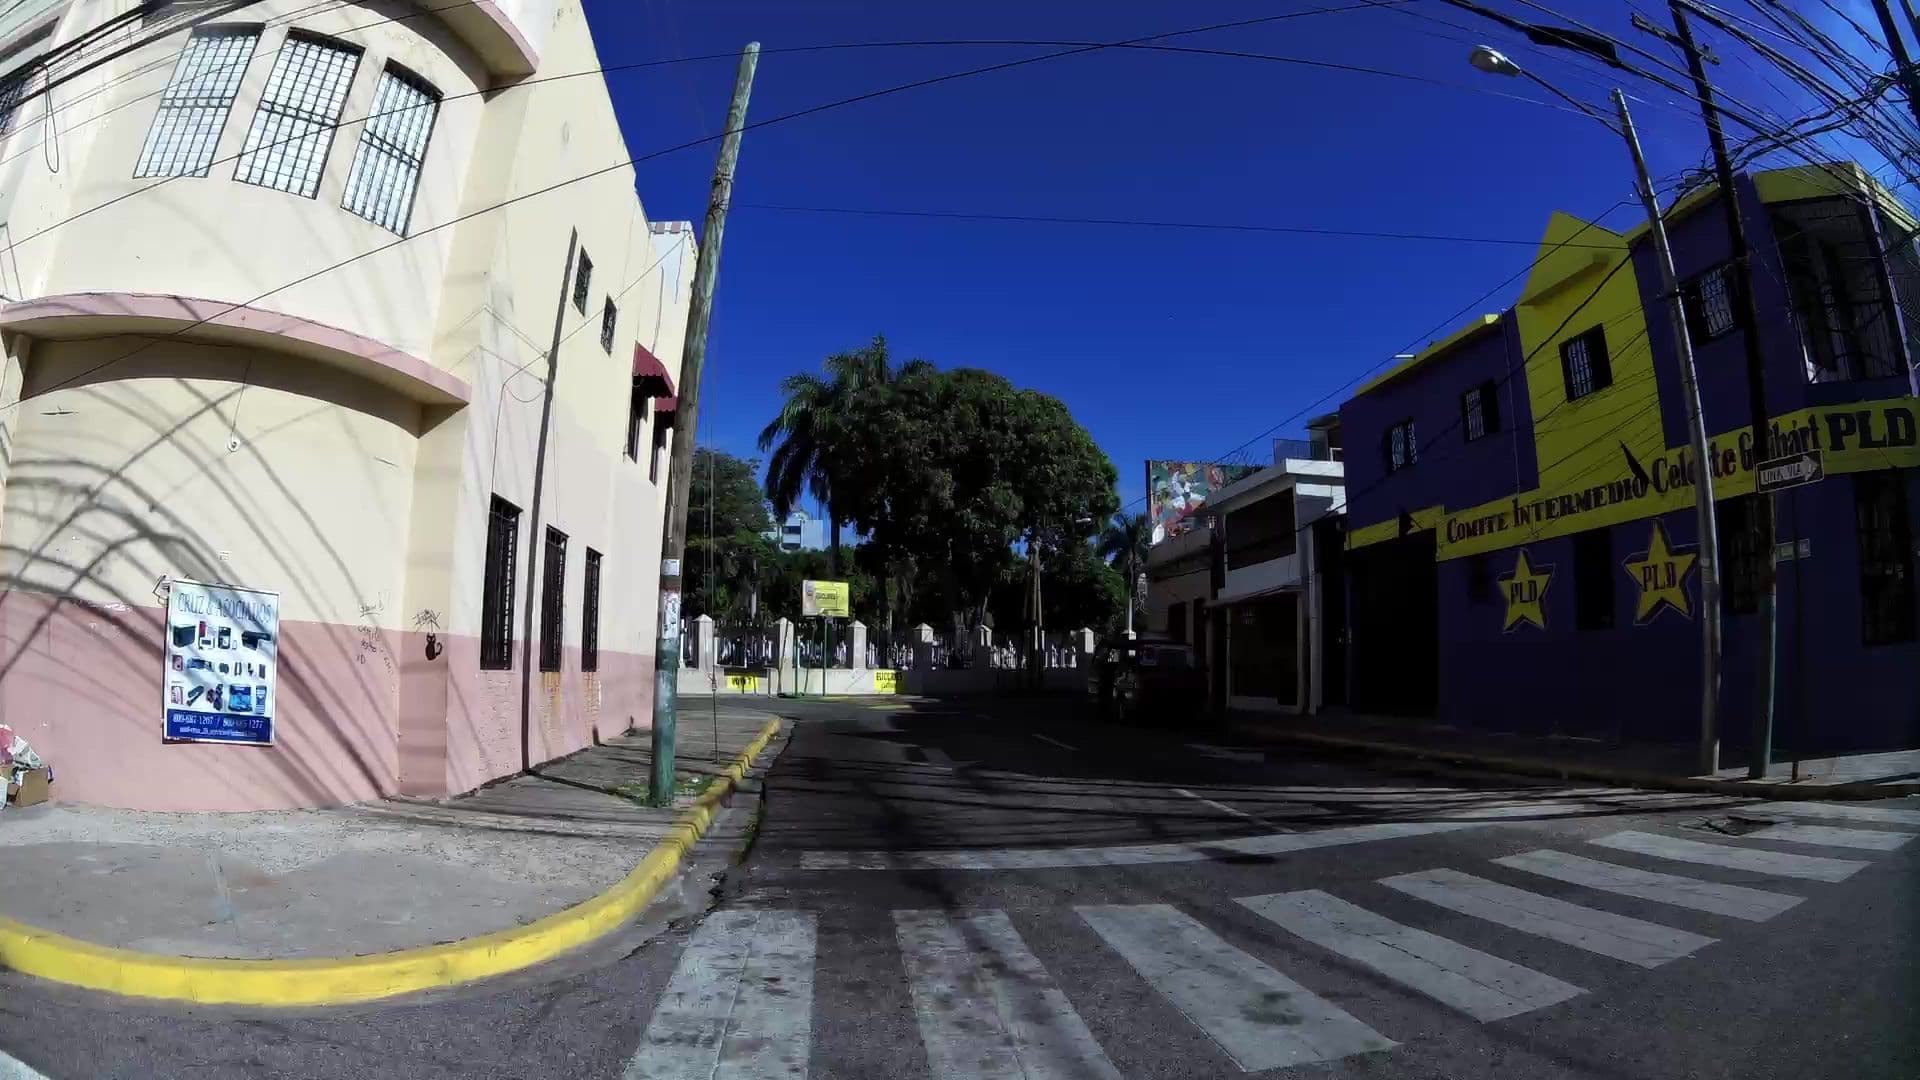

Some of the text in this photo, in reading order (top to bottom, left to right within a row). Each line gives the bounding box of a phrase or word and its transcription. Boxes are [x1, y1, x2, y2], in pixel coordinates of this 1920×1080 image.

[1447, 512, 1509, 543] COMITE
[1512, 478, 1649, 527] INTERMEDIO
[1825, 408, 1916, 450] PLD
[1643, 562, 1676, 592] PLD
[178, 592, 204, 614] CRUZ
[1511, 580, 1537, 606] PLD
